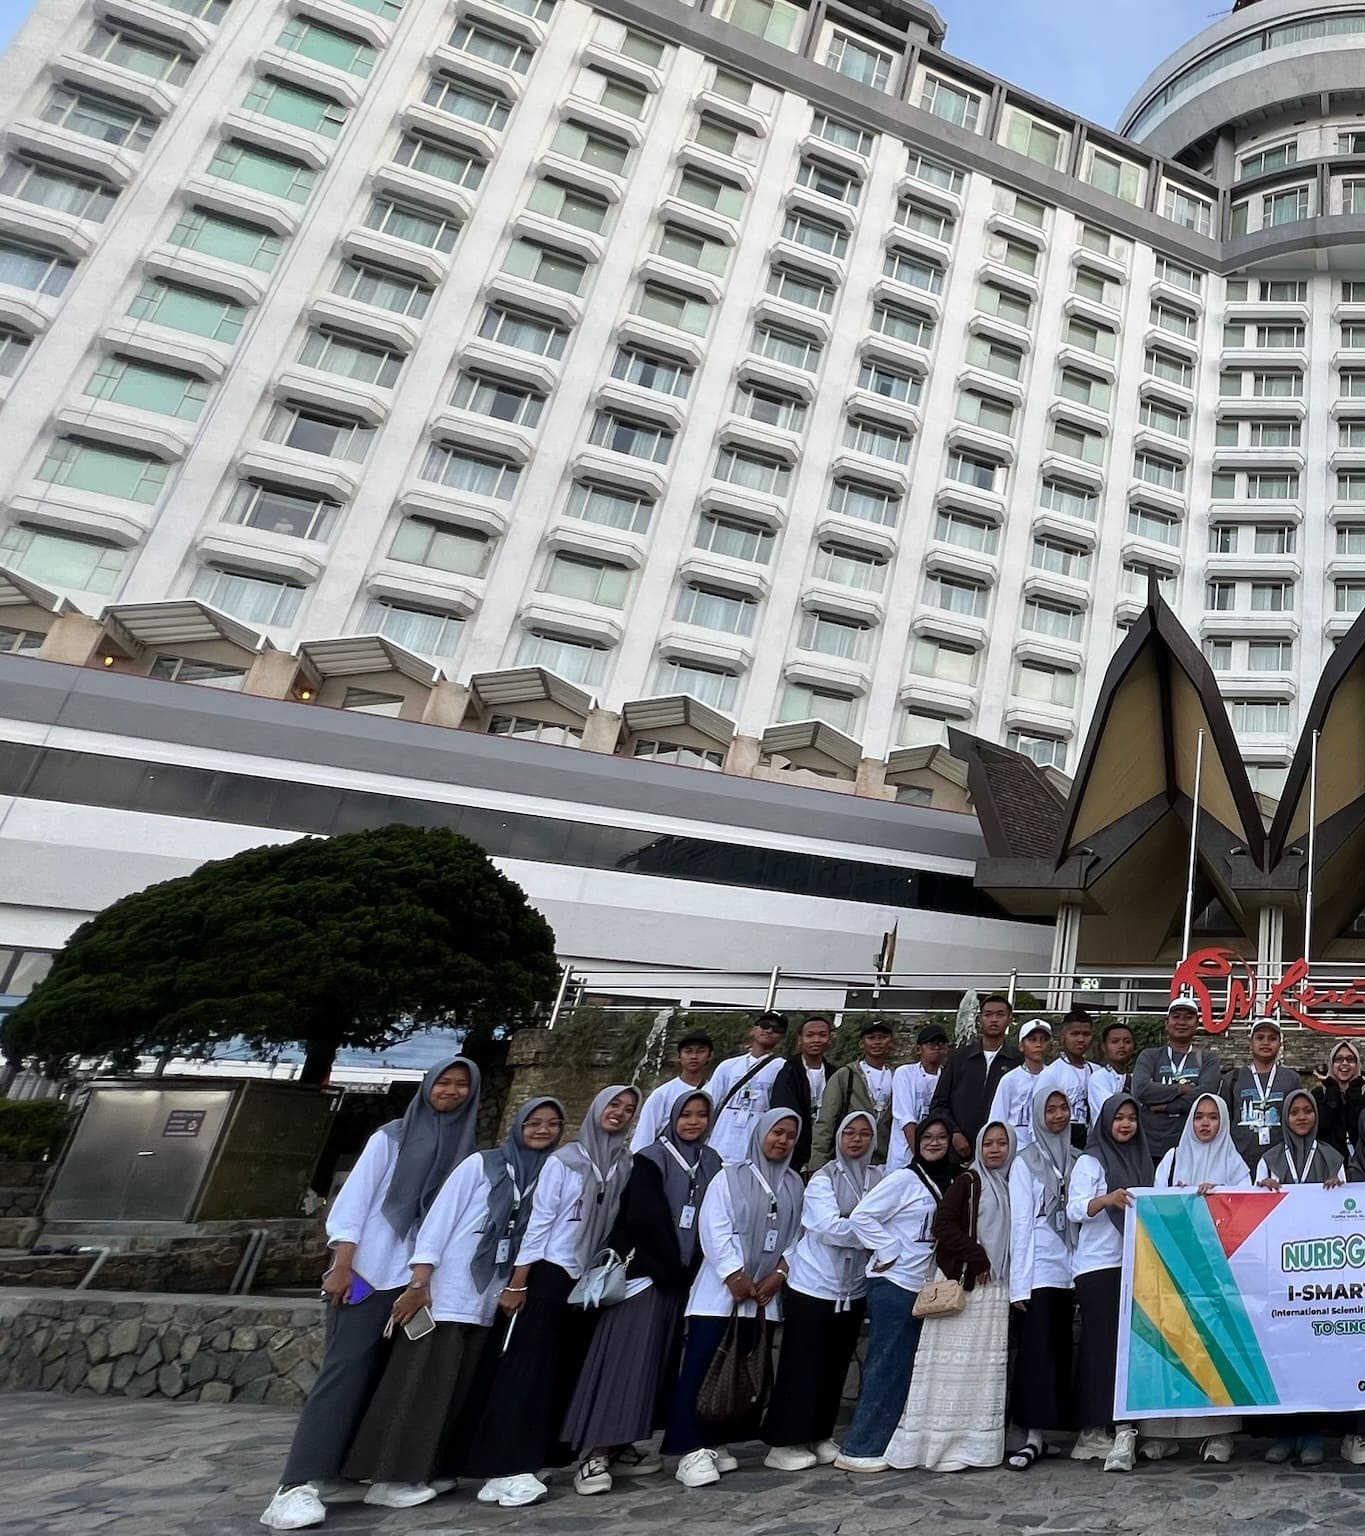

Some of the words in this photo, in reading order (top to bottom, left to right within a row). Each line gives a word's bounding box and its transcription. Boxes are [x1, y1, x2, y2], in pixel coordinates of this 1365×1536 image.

[1284, 1239, 1345, 1270] NURIS
[1271, 1306, 1329, 1318] (International
[1312, 1321, 1334, 1336] TO
